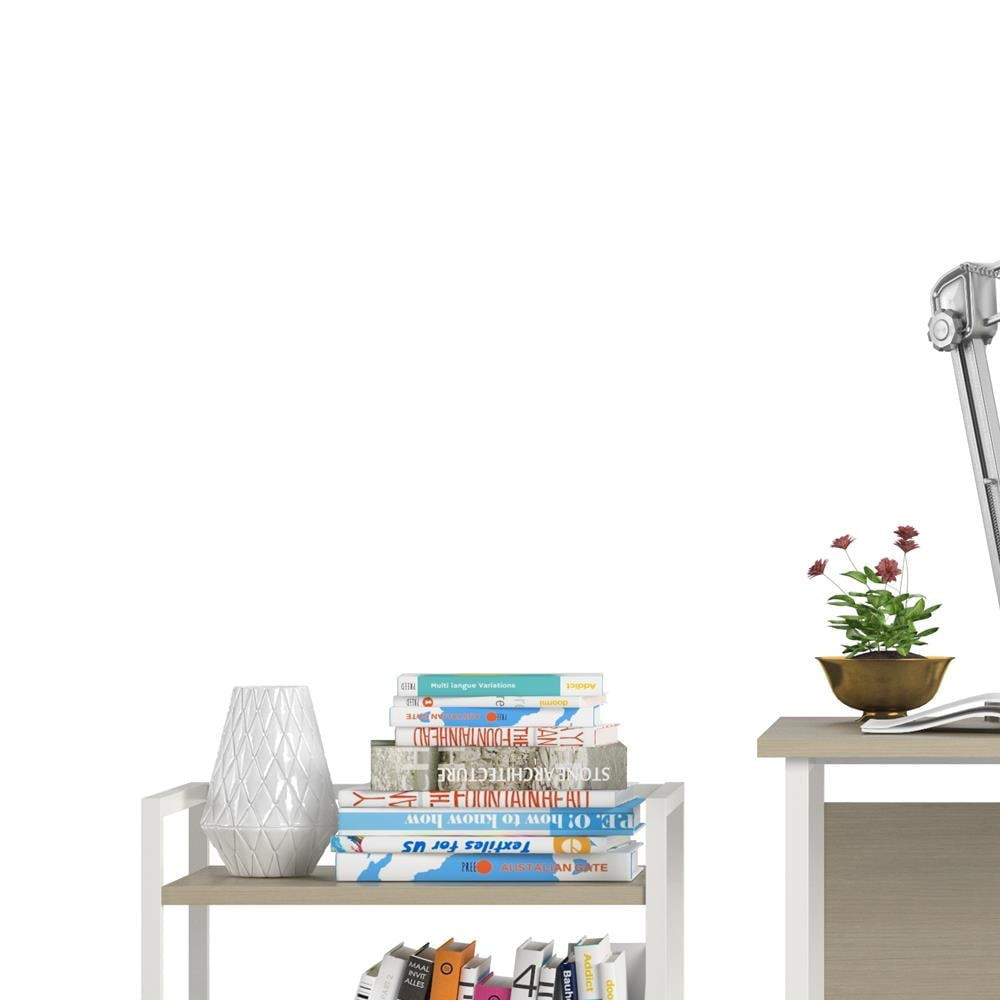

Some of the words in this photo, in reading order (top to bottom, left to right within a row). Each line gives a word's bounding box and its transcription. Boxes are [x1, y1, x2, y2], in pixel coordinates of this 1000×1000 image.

[451, 682, 476, 691] langue
[566, 682, 597, 690] Addict
[413, 727, 511, 747] FOUNTAINHEAD
[437, 766, 555, 782] ARCHITECTURE
[559, 766, 611, 782] STONE
[405, 813, 442, 829] how
[448, 813, 497, 829] know
[502, 813, 520, 827] to
[527, 813, 563, 829] how
[431, 840, 459, 853] for
[464, 840, 531, 853] Textiles
[574, 863, 609, 872] GATE
[408, 961, 430, 973] MAAL
[584, 953, 594, 992] Addict
[408, 969, 427, 980] INVIT
[512, 964, 537, 998] 4
[403, 977, 425, 989] ALLES
